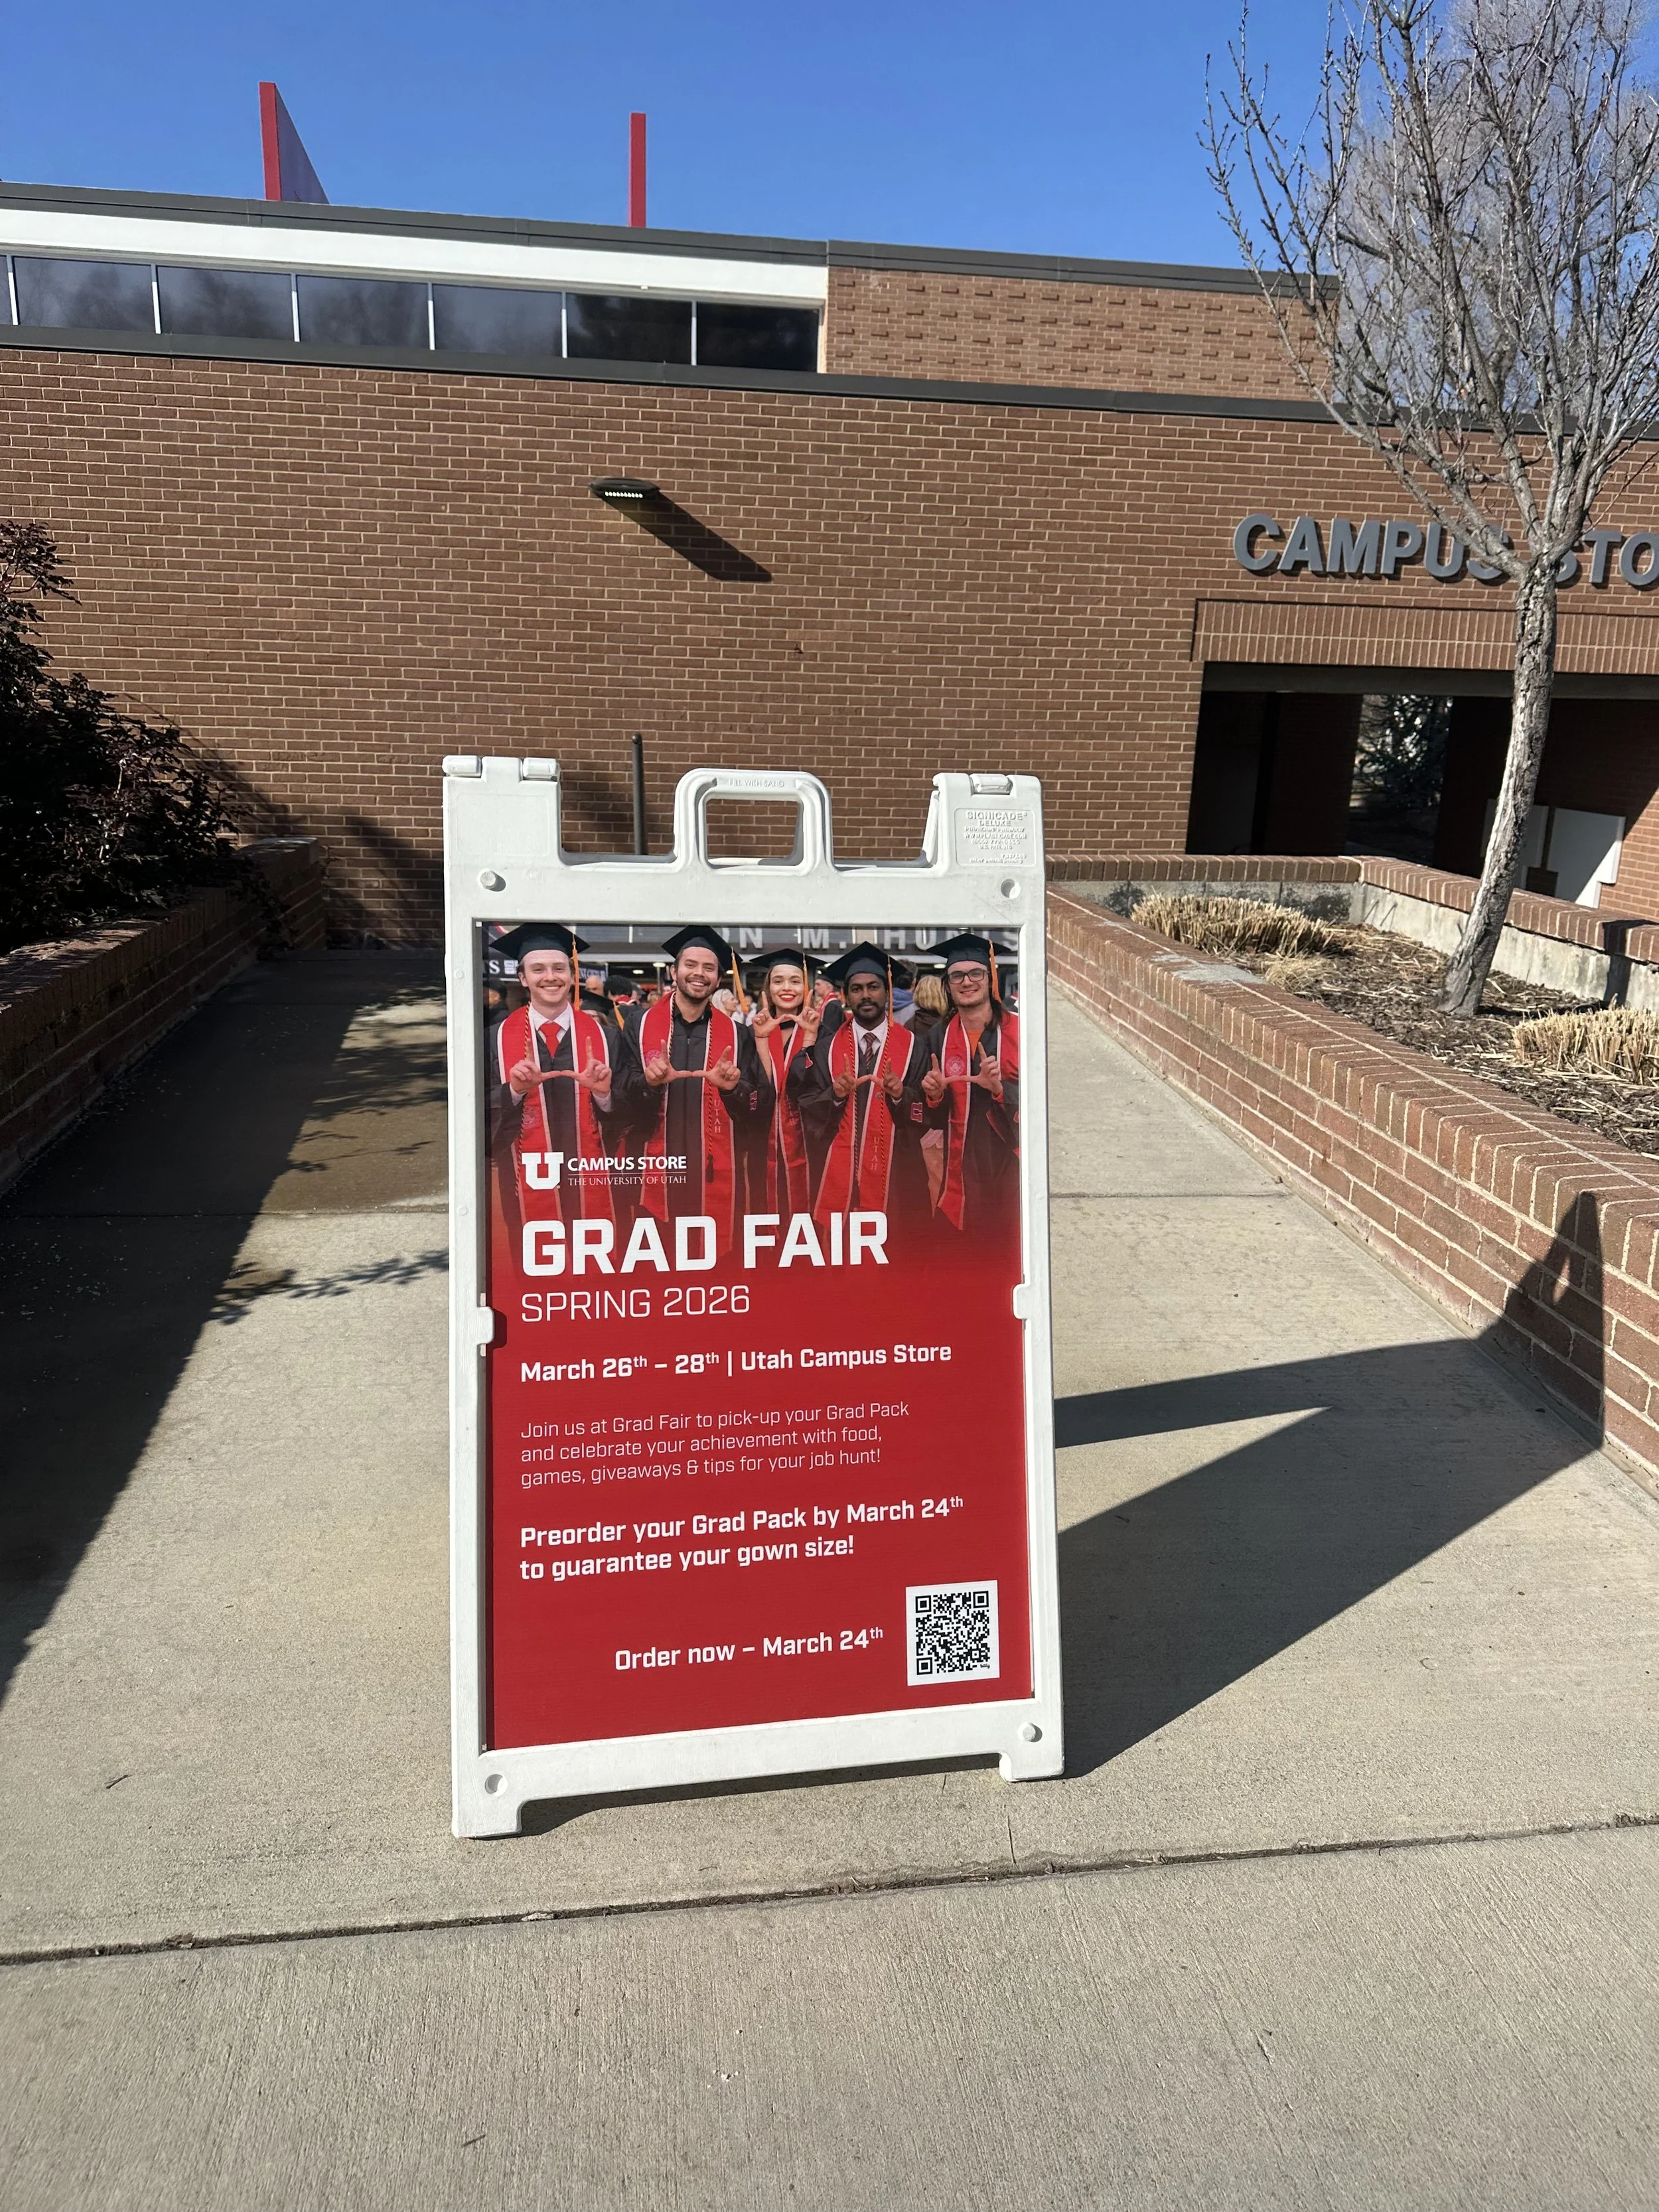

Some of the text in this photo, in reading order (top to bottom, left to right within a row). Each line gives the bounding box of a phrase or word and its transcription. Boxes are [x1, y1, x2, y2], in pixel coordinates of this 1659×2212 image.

[802, 928, 847, 949] M.
[522, 1152, 564, 1189] U
[567, 1155, 687, 1171] CAMPUS STORE
[870, 1136, 881, 1171] UTAH
[568, 1177, 587, 1186] THE
[589, 1176, 644, 1185] UNIVERSITY
[661, 1175, 687, 1184] UTAH
[522, 1211, 889, 1277] GRAD FAIR
[522, 1286, 750, 1323] SPRING 2026
[521, 1359, 595, 1382] March
[603, 1356, 648, 1379] 26th
[675, 1352, 719, 1374] 28th
[741, 1349, 793, 1372] Utah
[800, 1349, 887, 1370] Campus
[893, 1344, 952, 1364] Store
[521, 1401, 909, 1438] Join us at Grad Fair to pick-up your Grad Pack
[521, 1426, 882, 1462] and celebrate your achievement with food,
[521, 1449, 880, 1491] games, giveaways & tips for your job hunt!
[521, 1496, 964, 1548] Preorder your Grad Pack by March 24th
[519, 1534, 854, 1582] to guarantee your gown size!
[615, 1646, 682, 1670] Order
[688, 1644, 736, 1664] now
[763, 1632, 833, 1657] March
[839, 1627, 883, 1651] 24th
